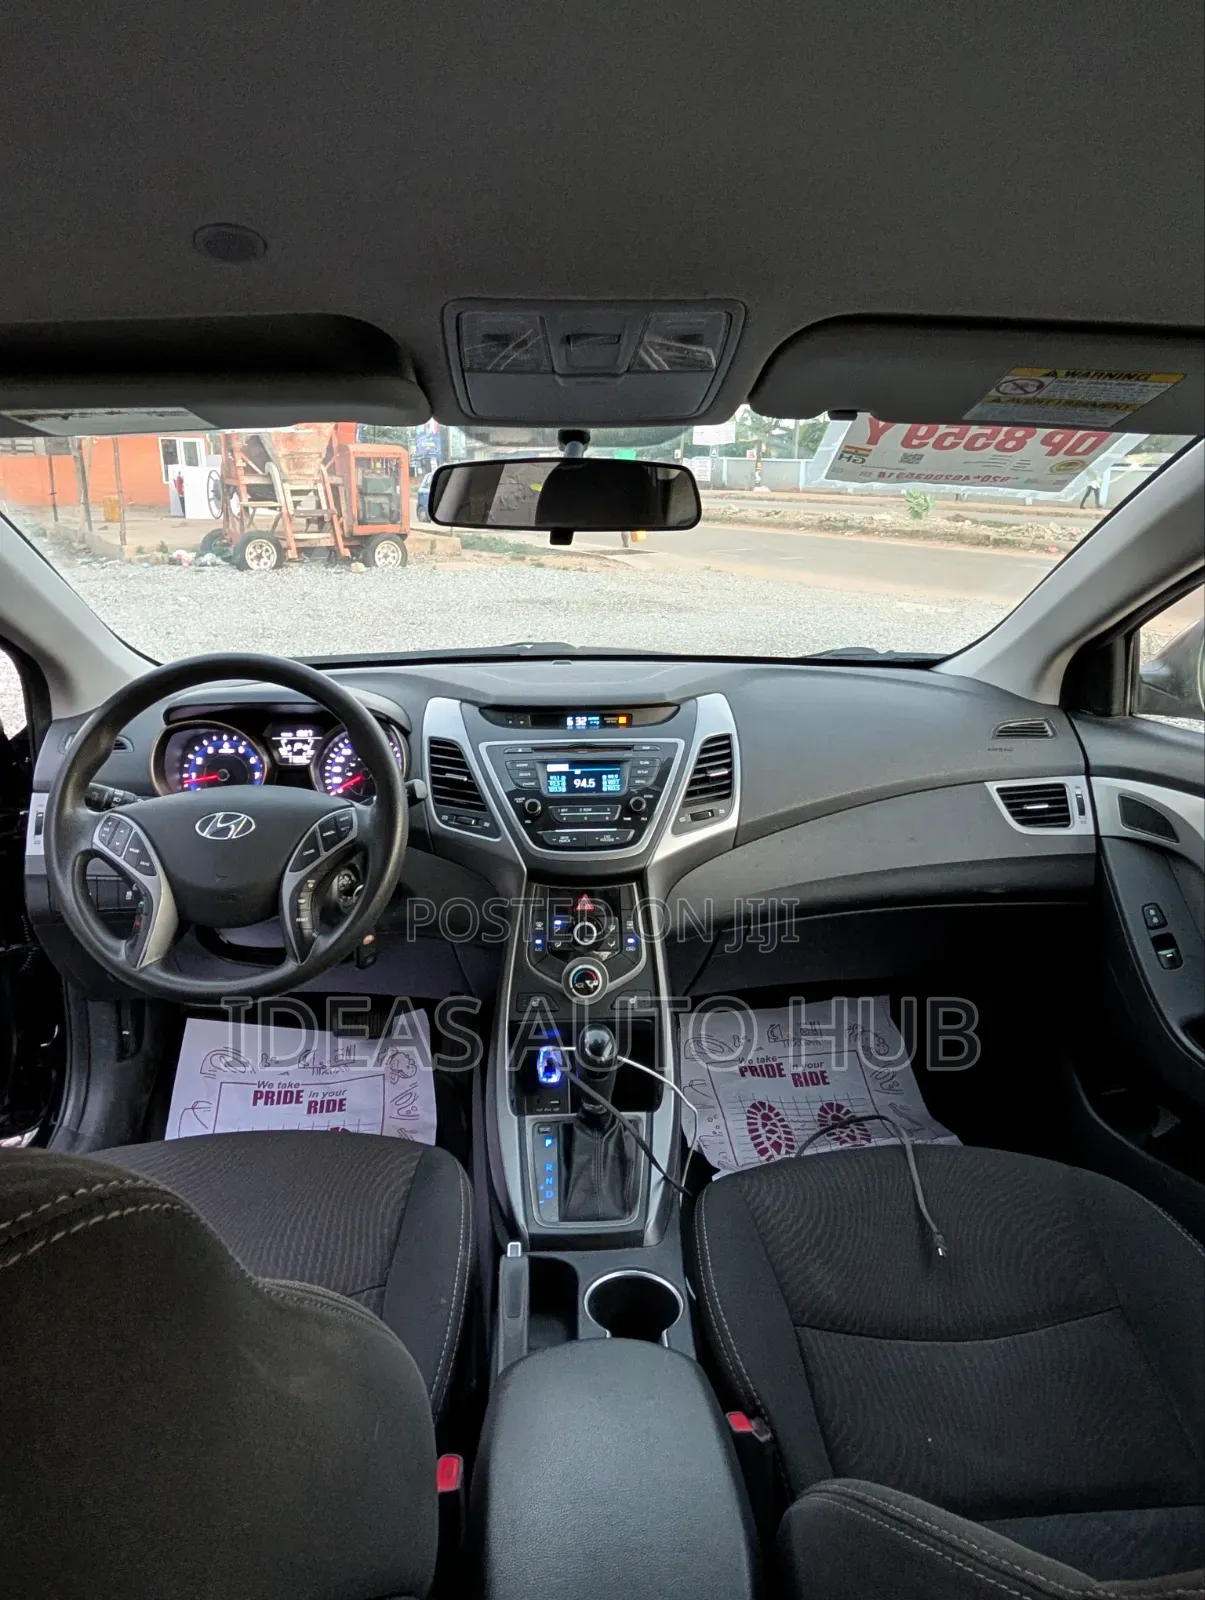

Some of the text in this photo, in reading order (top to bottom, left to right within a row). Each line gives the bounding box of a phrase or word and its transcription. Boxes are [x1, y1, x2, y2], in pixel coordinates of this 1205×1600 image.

[1064, 369, 1151, 382] WARNING
[757, 1055, 777, 1064] take
[738, 1062, 786, 1078] PRIDE
[803, 1061, 824, 1071] your
[791, 1070, 830, 1087] RIDE
[257, 1080, 300, 1089] We take
[252, 1089, 304, 1106] PRIDE
[308, 1089, 347, 1099] in your
[306, 1098, 347, 1115] RIDE
[545, 1138, 552, 1147] P
[545, 1177, 553, 1185] N
[545, 1190, 553, 1198] D
